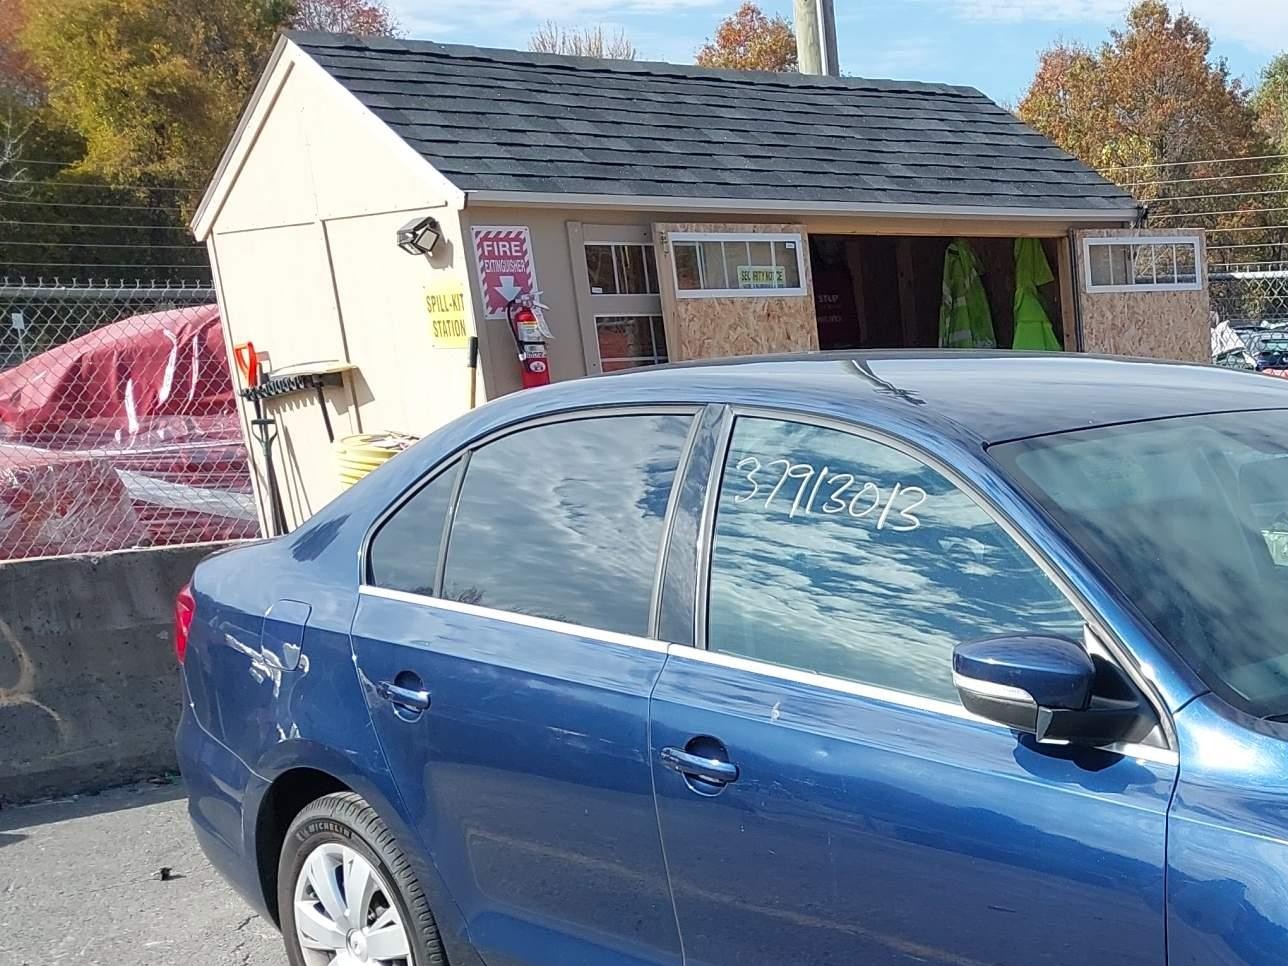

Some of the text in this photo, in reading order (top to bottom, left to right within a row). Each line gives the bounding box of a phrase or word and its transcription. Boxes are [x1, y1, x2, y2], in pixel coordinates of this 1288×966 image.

[483, 241, 522, 256] FIRE
[484, 259, 526, 272] EXTINGUISHER
[741, 270, 765, 281] SECRITY
[426, 293, 465, 313] SPILL-KIT
[432, 320, 467, 338] STATION
[735, 456, 927, 531] 37913013
